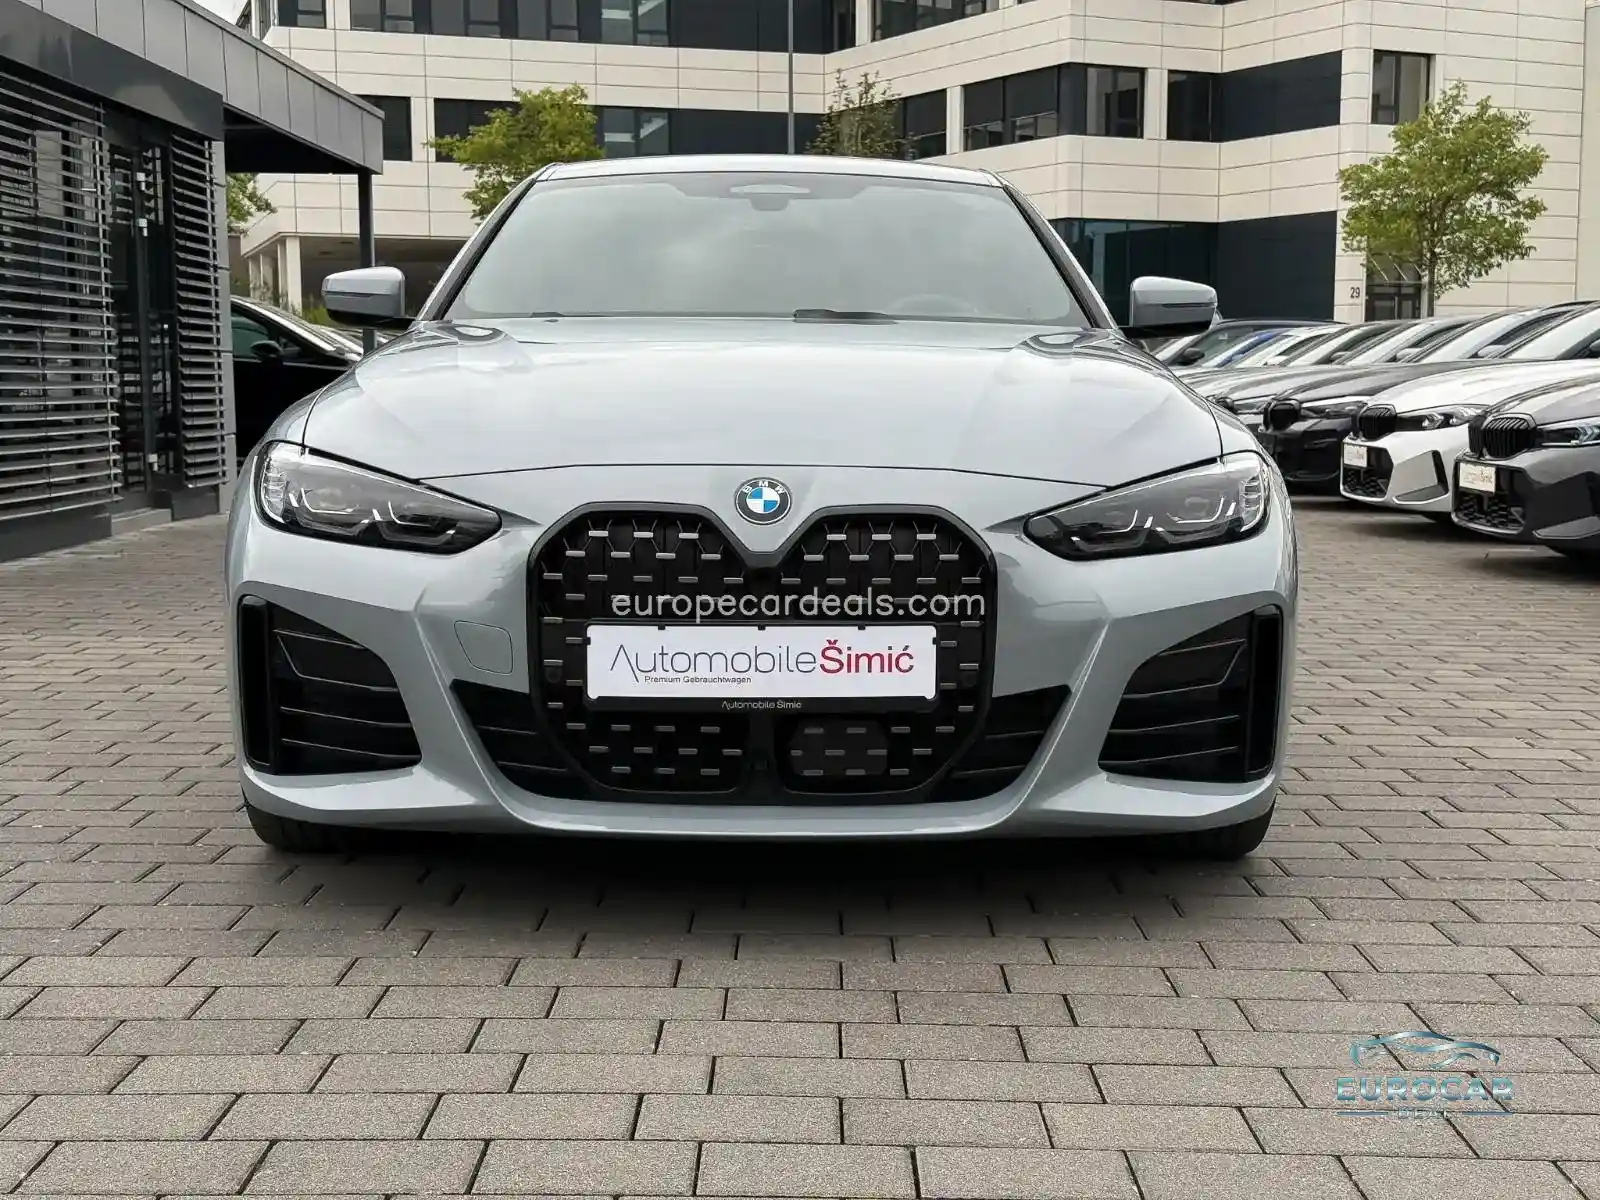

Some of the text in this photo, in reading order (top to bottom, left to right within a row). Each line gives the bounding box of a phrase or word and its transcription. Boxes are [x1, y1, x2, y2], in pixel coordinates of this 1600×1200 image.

[1350, 287, 1361, 299] 29
[742, 480, 785, 494] BMW
[645, 675, 752, 685] Premium Gebrauchtwagen
[721, 700, 775, 710] Automobile
